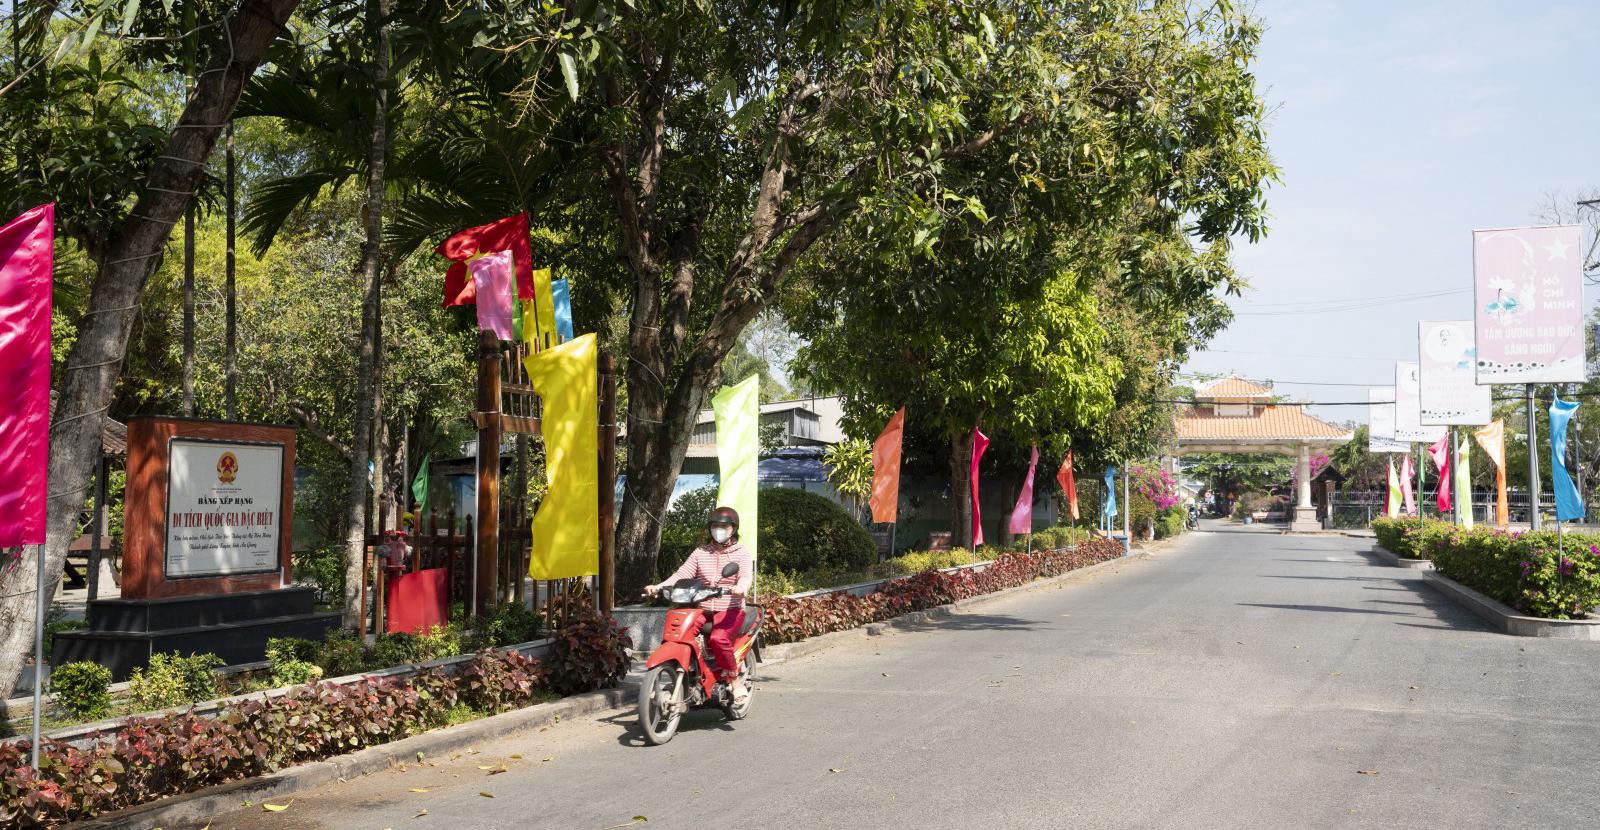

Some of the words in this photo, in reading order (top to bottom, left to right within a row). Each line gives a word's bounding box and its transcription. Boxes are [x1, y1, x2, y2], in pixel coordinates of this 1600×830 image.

[1543, 299, 1575, 310] MINH
[184, 508, 203, 528] TÍCH
[204, 505, 226, 530] QUỐC
[226, 511, 239, 527] GIA
